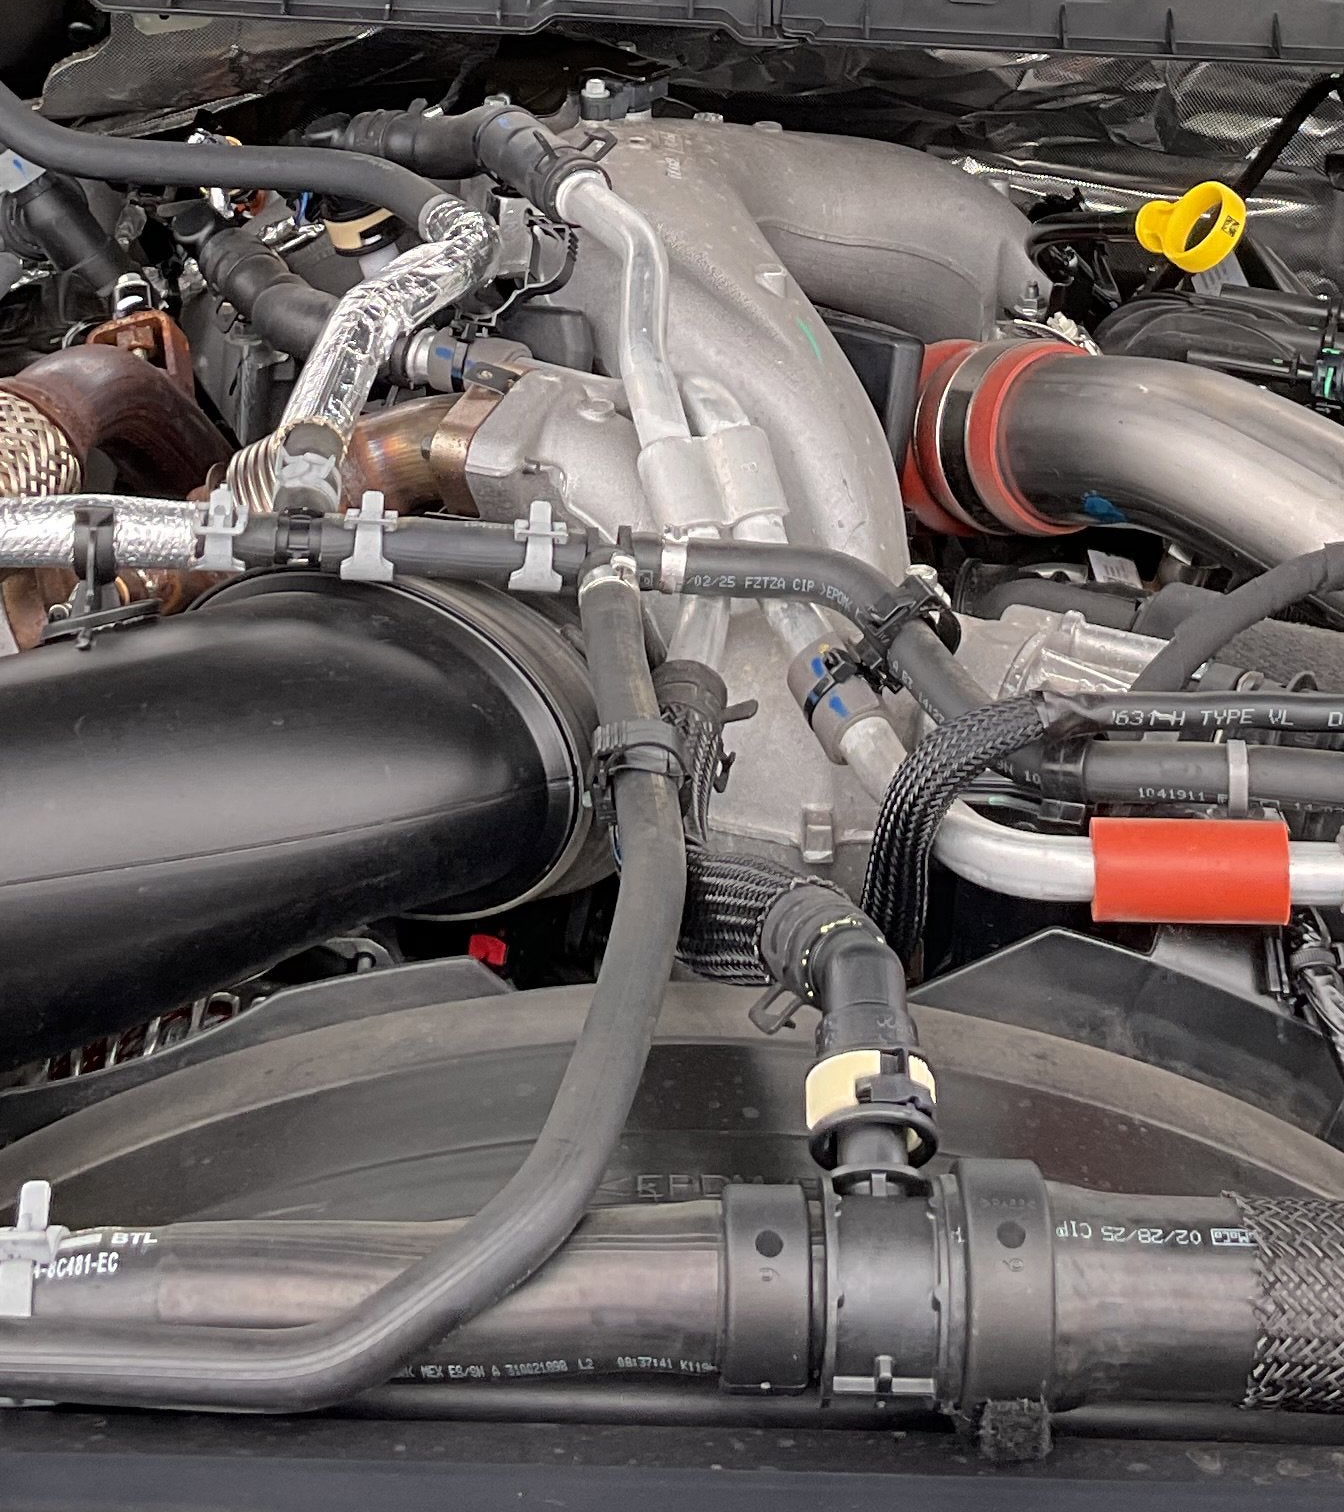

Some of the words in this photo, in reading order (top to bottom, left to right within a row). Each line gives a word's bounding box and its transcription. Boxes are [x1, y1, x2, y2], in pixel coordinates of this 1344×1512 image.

[687, 575, 736, 587] /02/25
[793, 578, 815, 592] CIP
[1201, 708, 1256, 727] TYPE
[1268, 709, 1295, 727] VL
[111, 1232, 158, 1245] BTL
[1101, 1224, 1202, 1245] 02/28/25
